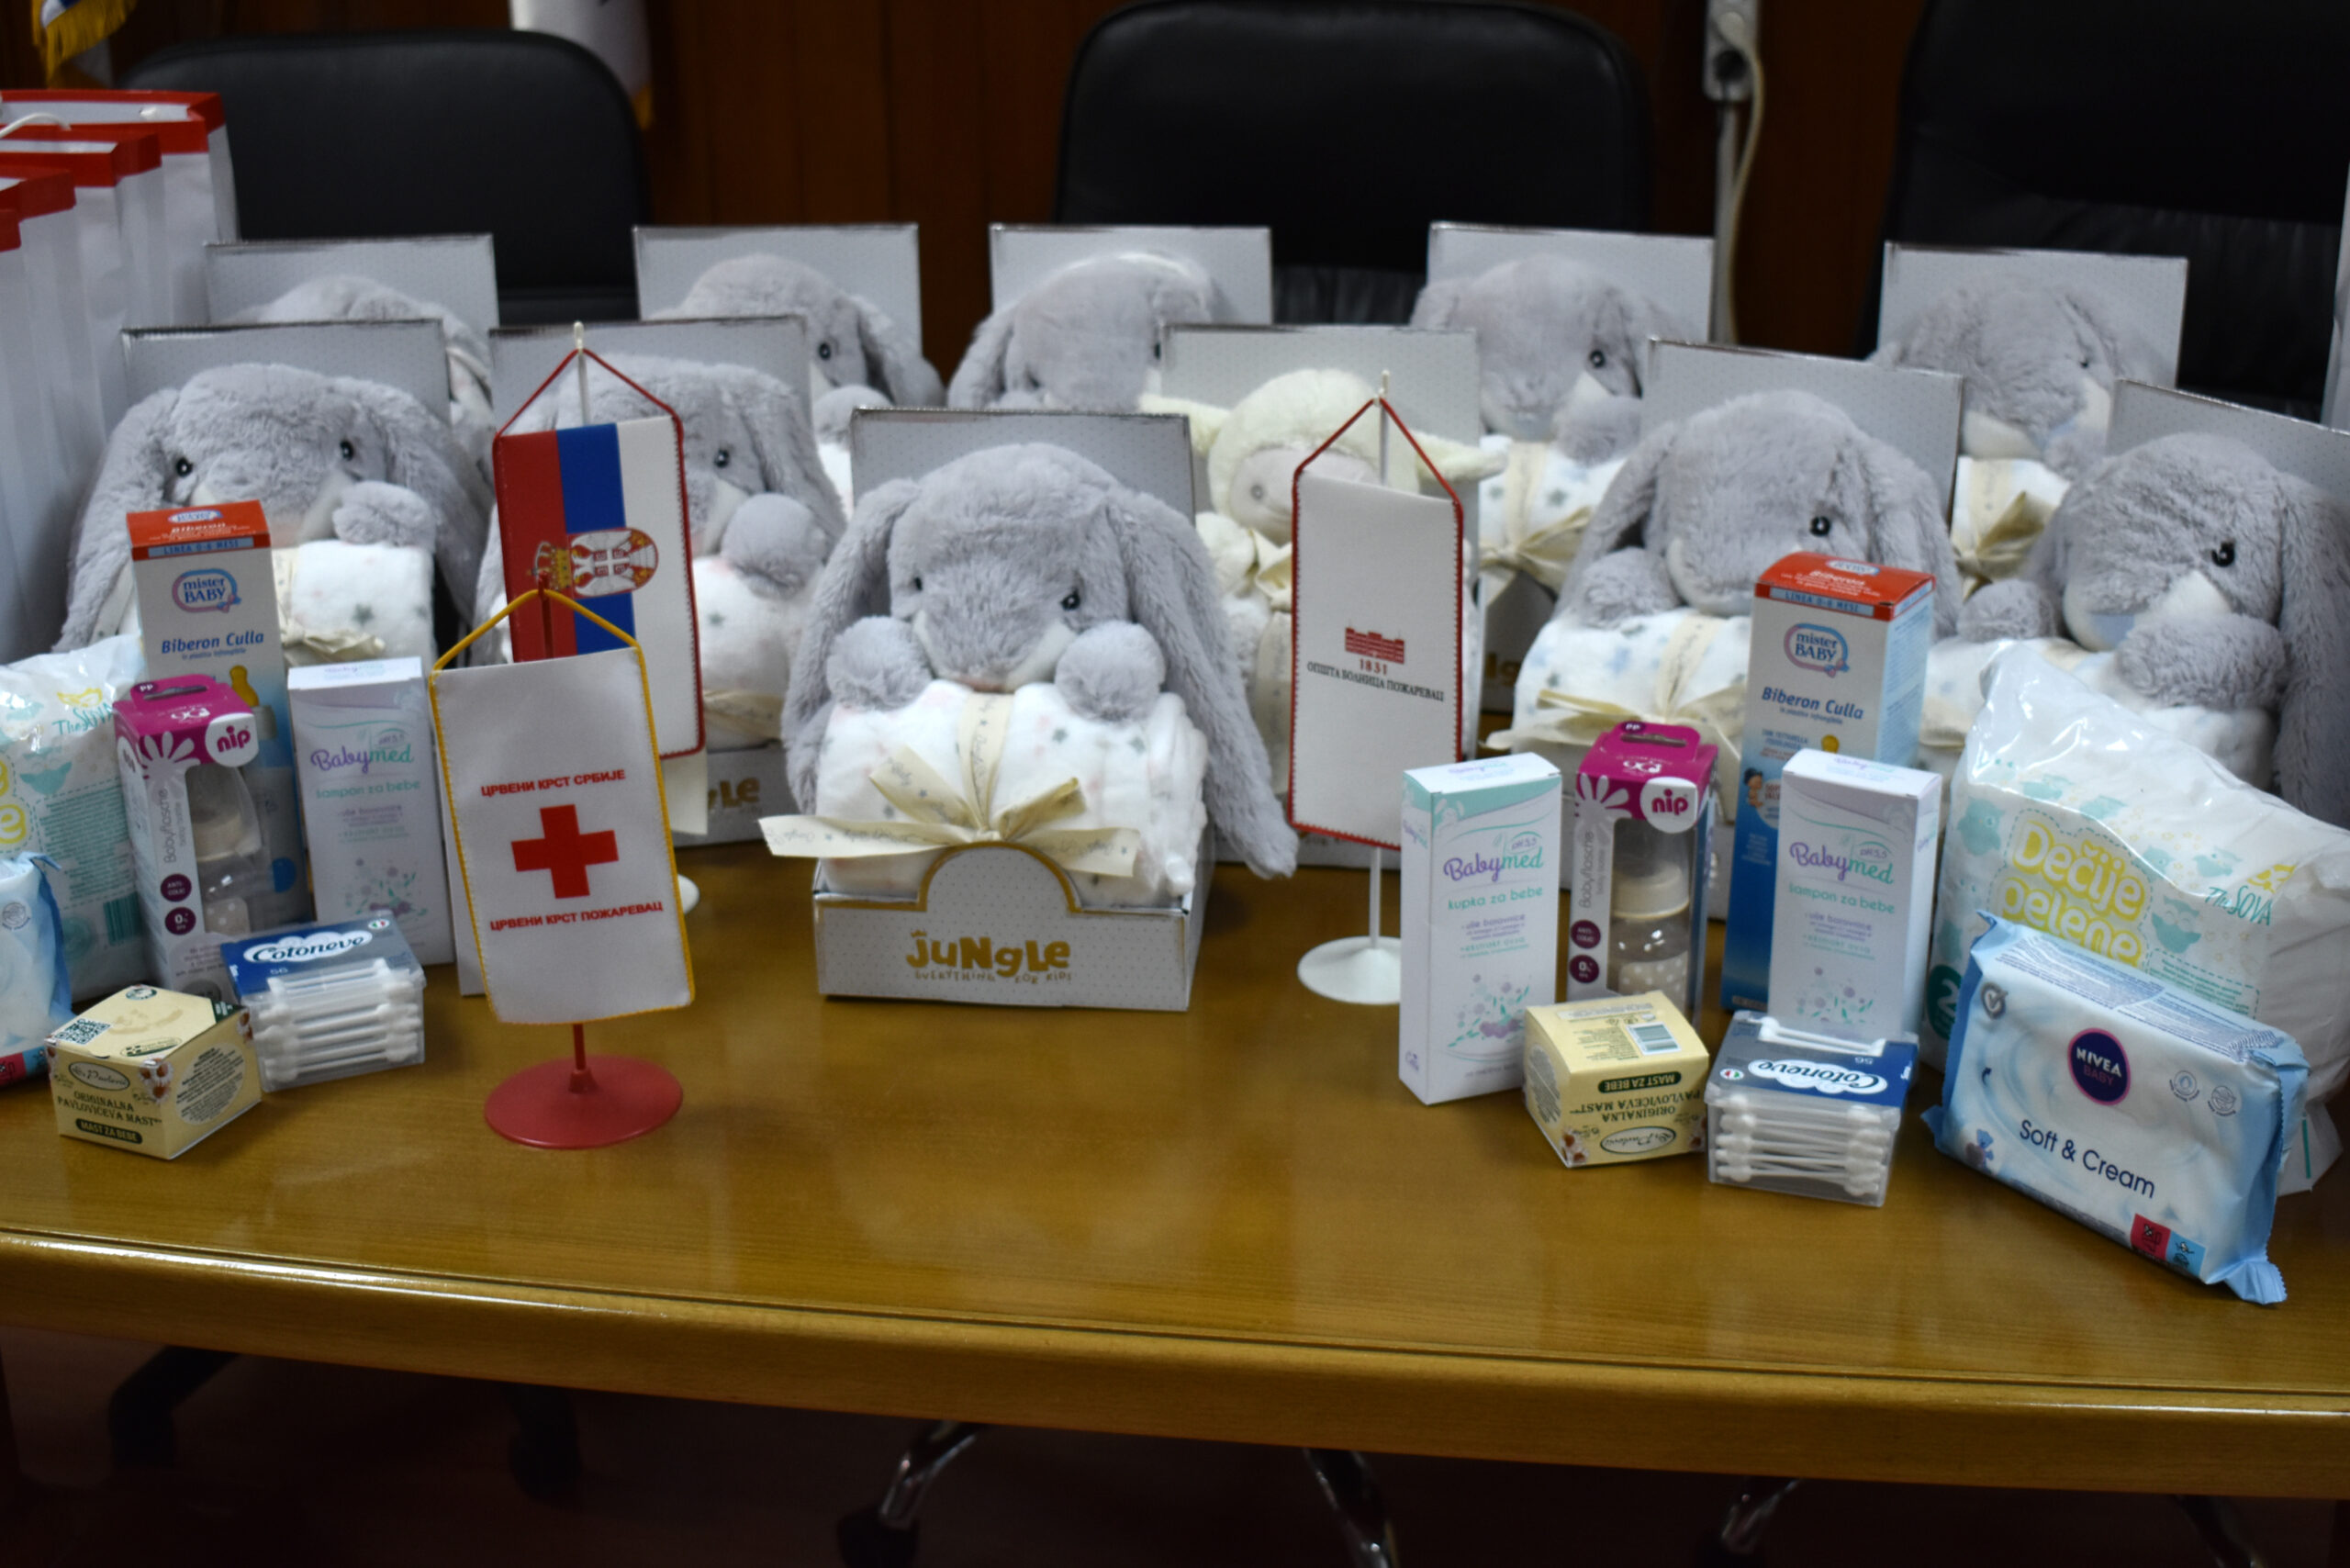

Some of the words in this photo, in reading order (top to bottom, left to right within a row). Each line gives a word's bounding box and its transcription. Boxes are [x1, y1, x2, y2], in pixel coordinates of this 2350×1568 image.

[183, 577, 226, 590] mister
[185, 587, 228, 604] BABY
[1785, 590, 1814, 604] LINEA
[1835, 599, 1860, 612] MESI
[161, 636, 220, 655] Biberon
[226, 631, 264, 647] Culla
[1796, 632, 1839, 648] mister
[1795, 644, 1838, 663] BABY
[1341, 669, 1385, 689] БОЛНИЦА
[1386, 679, 1445, 701] ПОЖАРЕВАЦ
[1761, 686, 1820, 711] Biberon
[1824, 700, 1864, 721] Culla
[215, 724, 252, 753] nip
[310, 744, 415, 774] Babymed
[368, 784, 384, 795] za
[386, 780, 421, 792] bebe
[481, 780, 536, 797] ЦРВЕНИ
[538, 776, 571, 790] КРСТ
[574, 768, 627, 785] СРБИЈЕ
[1651, 788, 1689, 816] nip
[1443, 846, 1545, 882] Babymed
[1789, 841, 1895, 884] Babymed
[2016, 823, 2144, 919] Dečije
[1448, 893, 1486, 911] kupka
[1490, 892, 1506, 904] za
[1510, 886, 1544, 902] bebe
[1841, 893, 1857, 906] za
[1860, 896, 1896, 914] bebe
[2228, 885, 2274, 926] SOVA
[490, 915, 544, 932] ЦРВЕНИ
[546, 913, 578, 925] КРСТ
[580, 901, 665, 922] ПОЖАРЕВАЦ
[2002, 878, 2141, 964] pelene
[252, 935, 364, 962] Cotoneve
[915, 969, 997, 983] EVERYTHING
[1014, 974, 1039, 985] FOR
[1046, 970, 1073, 981] KIDS
[2076, 1047, 2122, 1078] NIVEA
[1603, 1080, 1629, 1092] BEBE
[1630, 1079, 1645, 1088] ZA
[1646, 1073, 1676, 1087] MAST
[1758, 1060, 1880, 1090] Cotoneve
[2083, 1064, 2115, 1086] BABY
[73, 1090, 135, 1113] ORIGINALNA
[1579, 1101, 1614, 1114] MAST
[126, 1113, 154, 1126] MAST
[1601, 1105, 1676, 1123] ORIGINALNA
[2019, 1119, 2058, 1153] Soft
[2061, 1139, 2076, 1163] &
[2082, 1148, 2155, 1199] Cream
